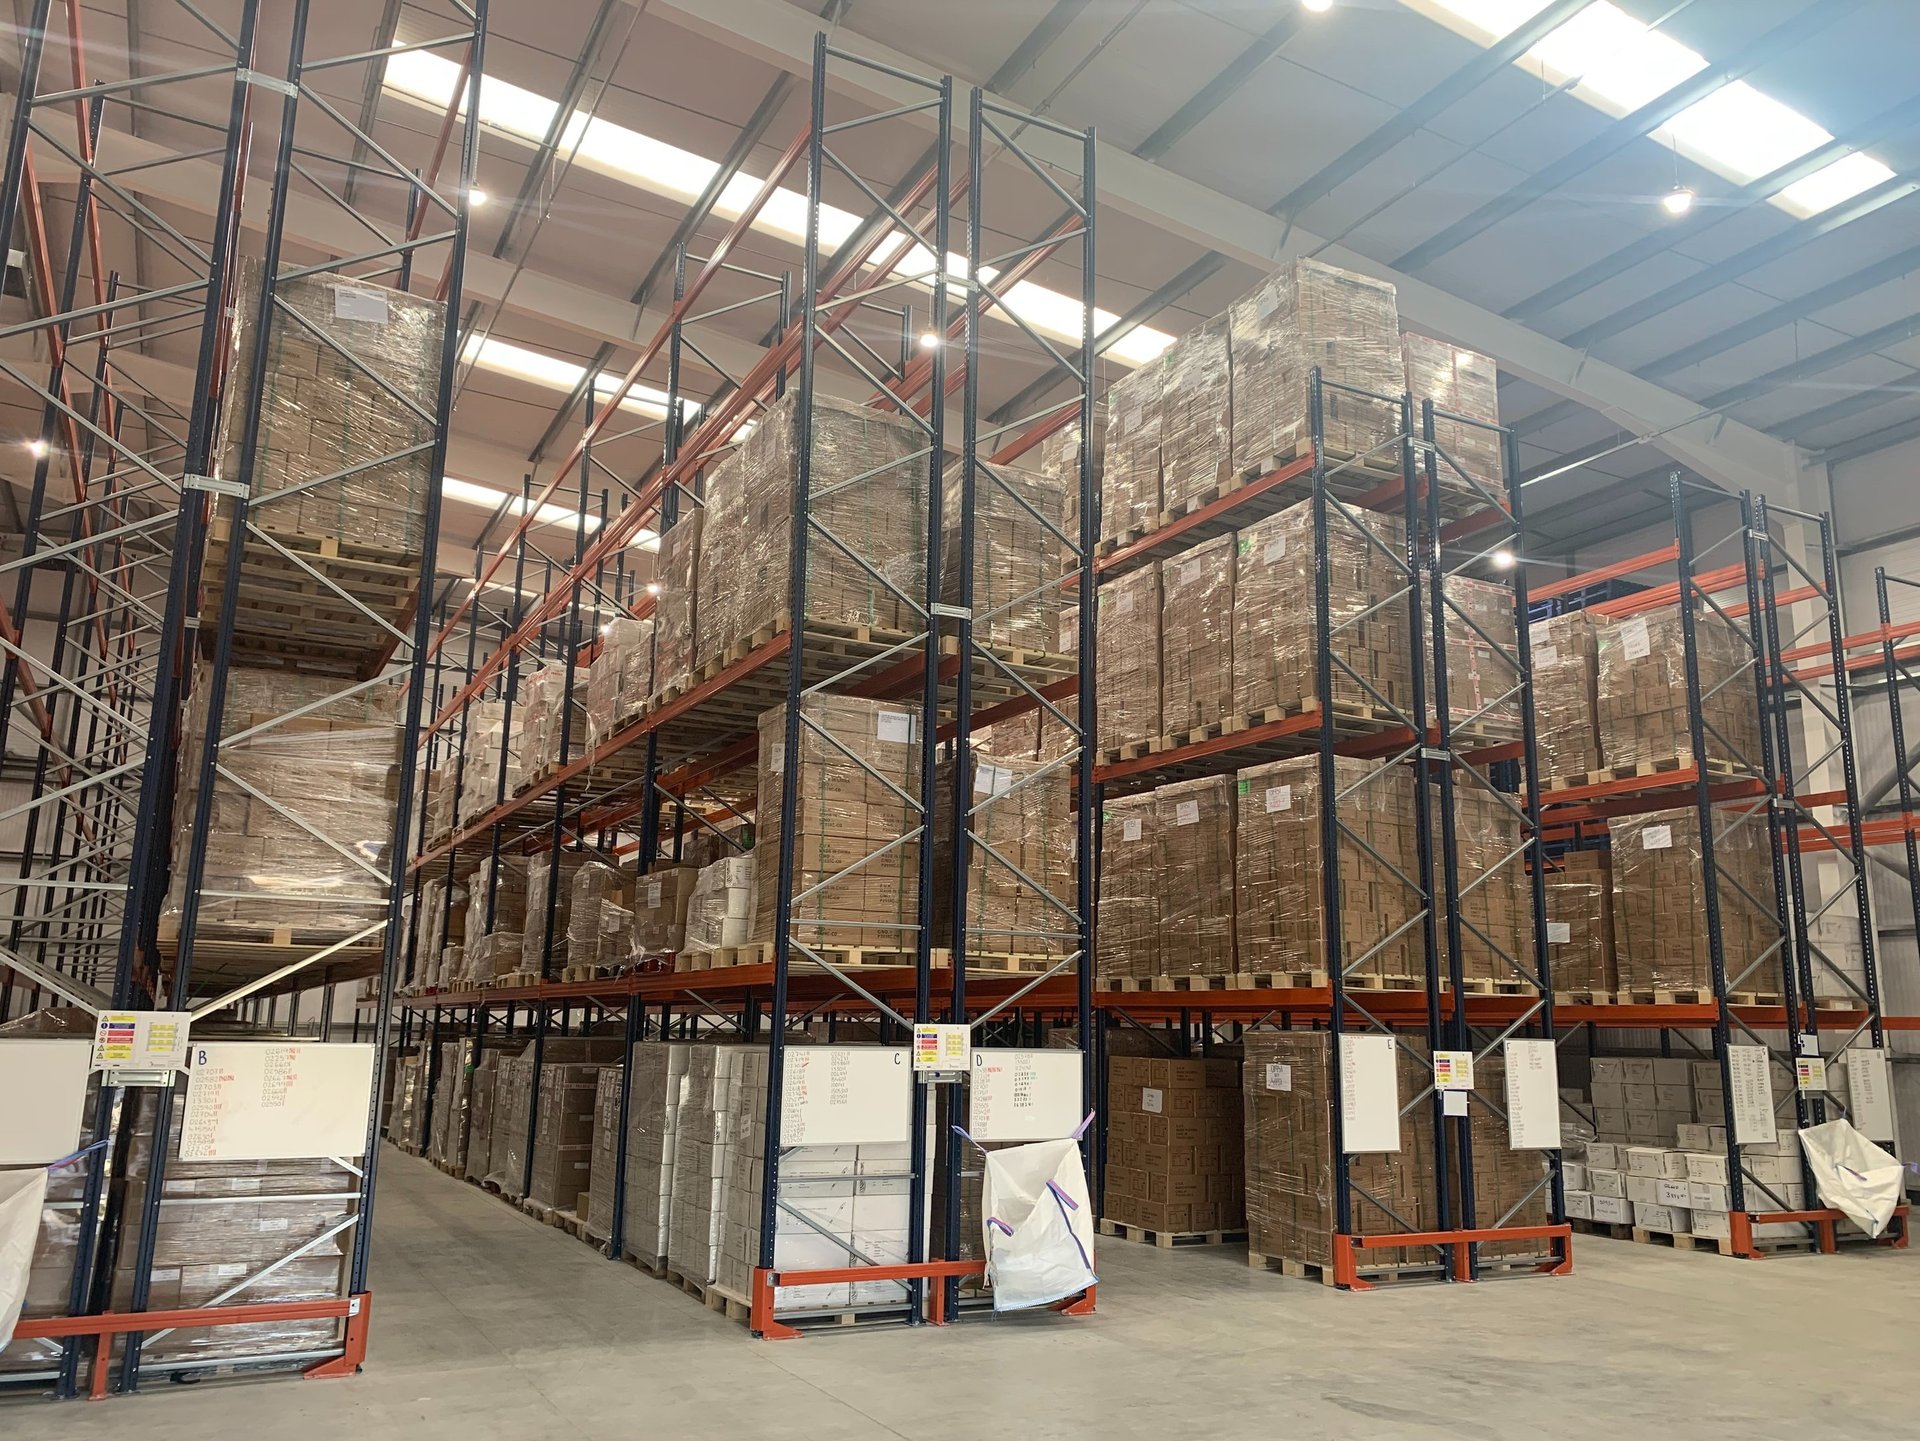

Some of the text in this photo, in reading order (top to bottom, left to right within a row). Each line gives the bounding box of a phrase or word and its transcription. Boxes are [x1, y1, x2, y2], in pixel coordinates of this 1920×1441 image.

[1387, 1038, 1392, 1050] E
[198, 1050, 208, 1066] B
[894, 1052, 901, 1065] C
[976, 1054, 983, 1067] D
